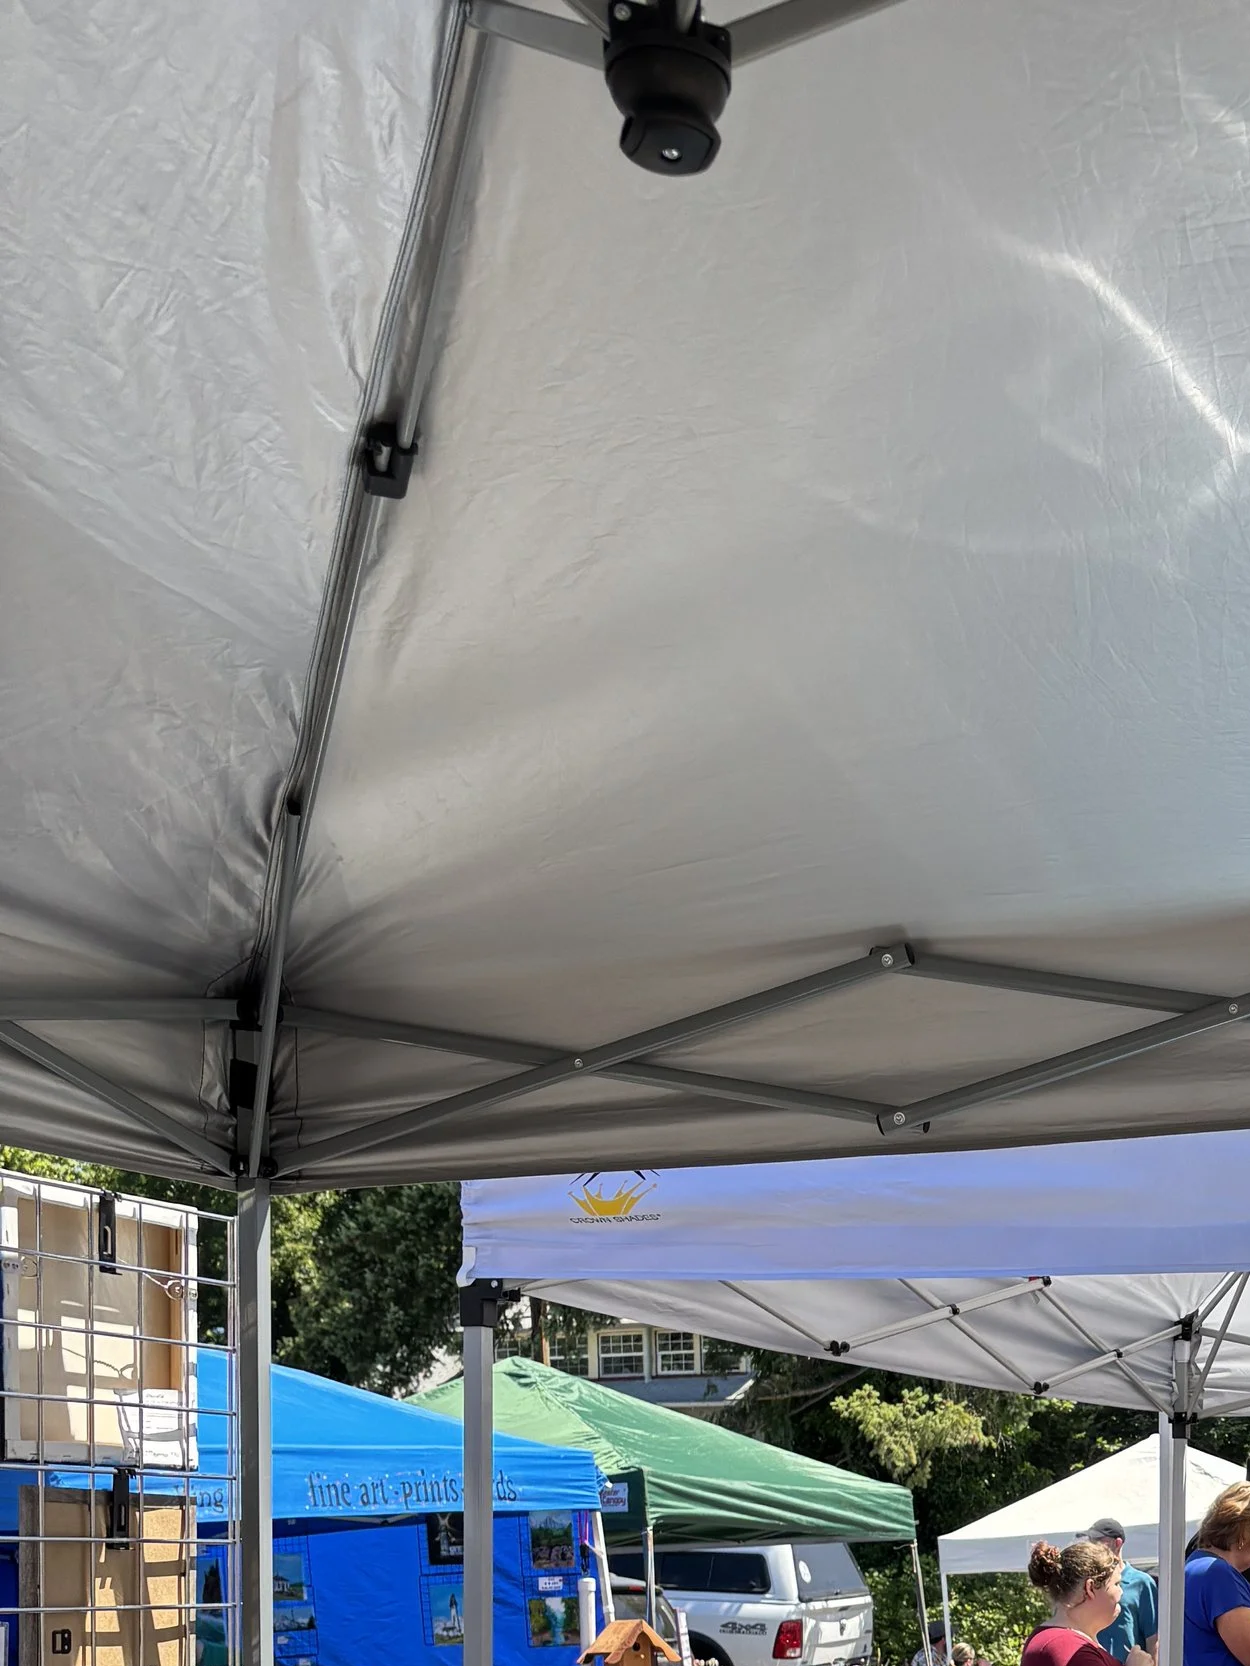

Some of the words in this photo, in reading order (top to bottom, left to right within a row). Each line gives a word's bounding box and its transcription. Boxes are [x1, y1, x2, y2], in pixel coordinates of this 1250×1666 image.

[308, 1471, 351, 1507] fine
[359, 1479, 389, 1507] art
[400, 1469, 459, 1511] prints
